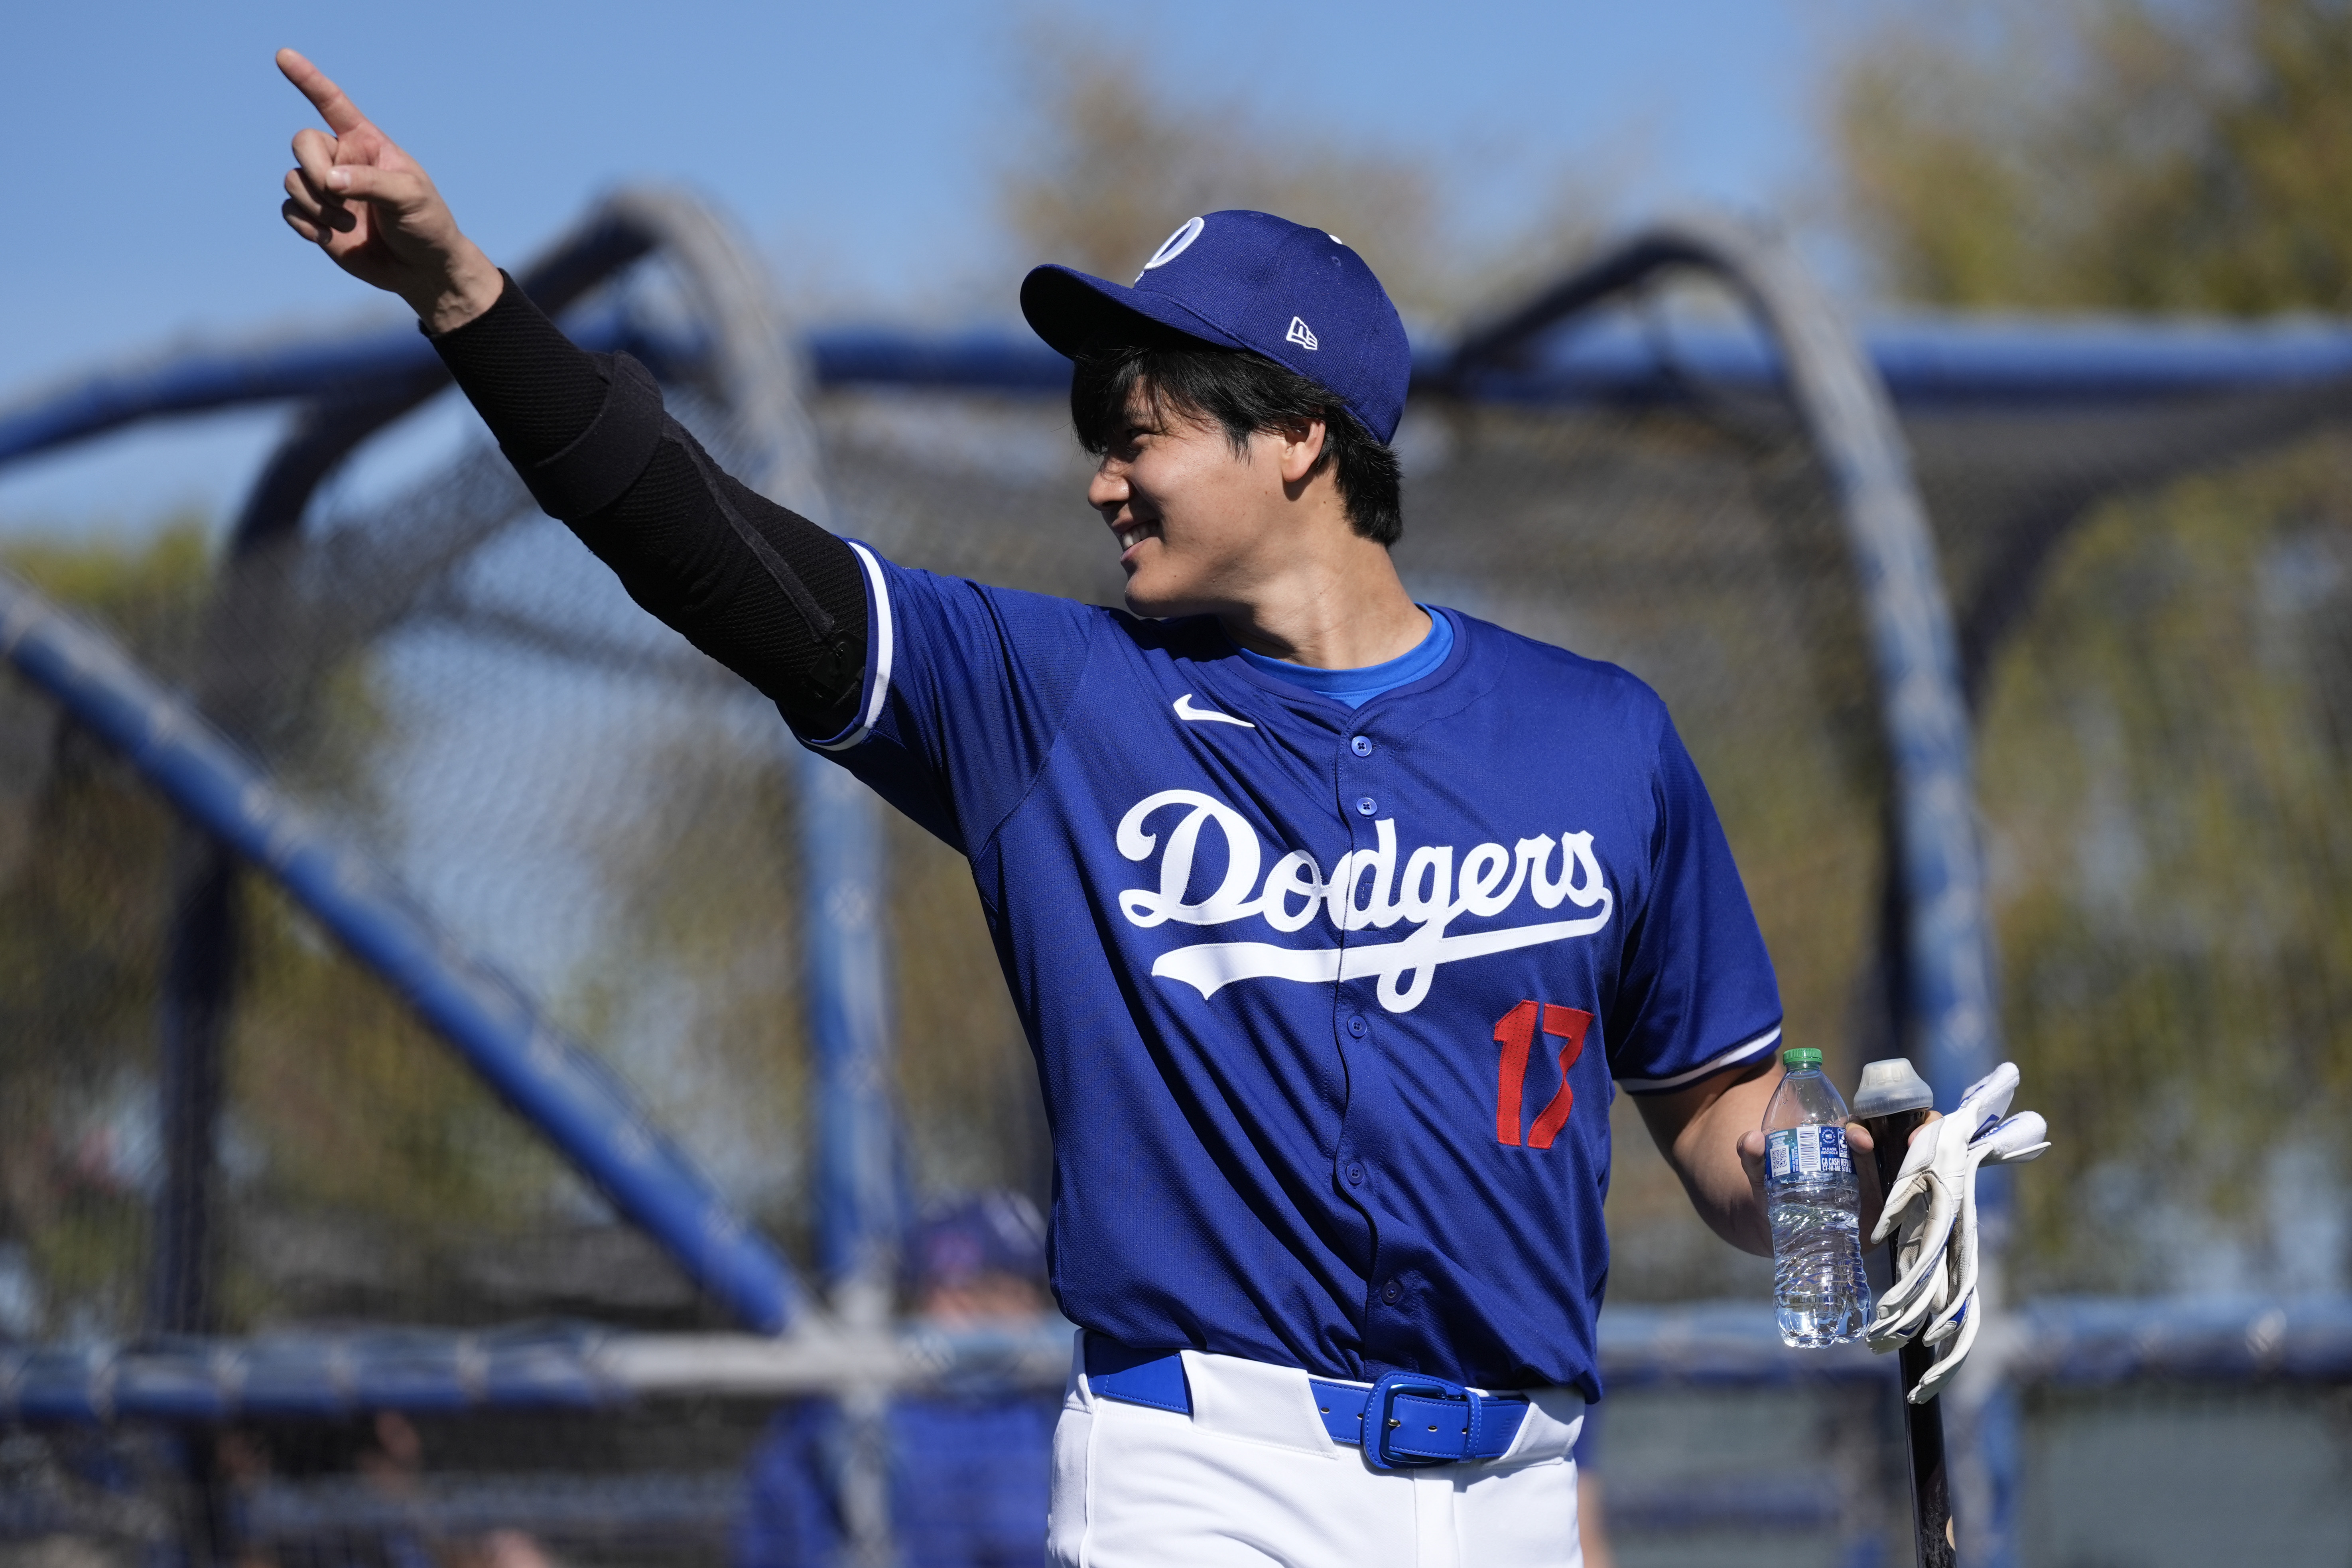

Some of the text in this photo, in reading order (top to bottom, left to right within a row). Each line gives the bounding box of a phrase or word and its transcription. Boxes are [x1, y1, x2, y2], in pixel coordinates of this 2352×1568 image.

[1117, 789, 1612, 1013] Dodgers
[1493, 999, 1594, 1149] 17
[1828, 1158, 1840, 1166] CASH
